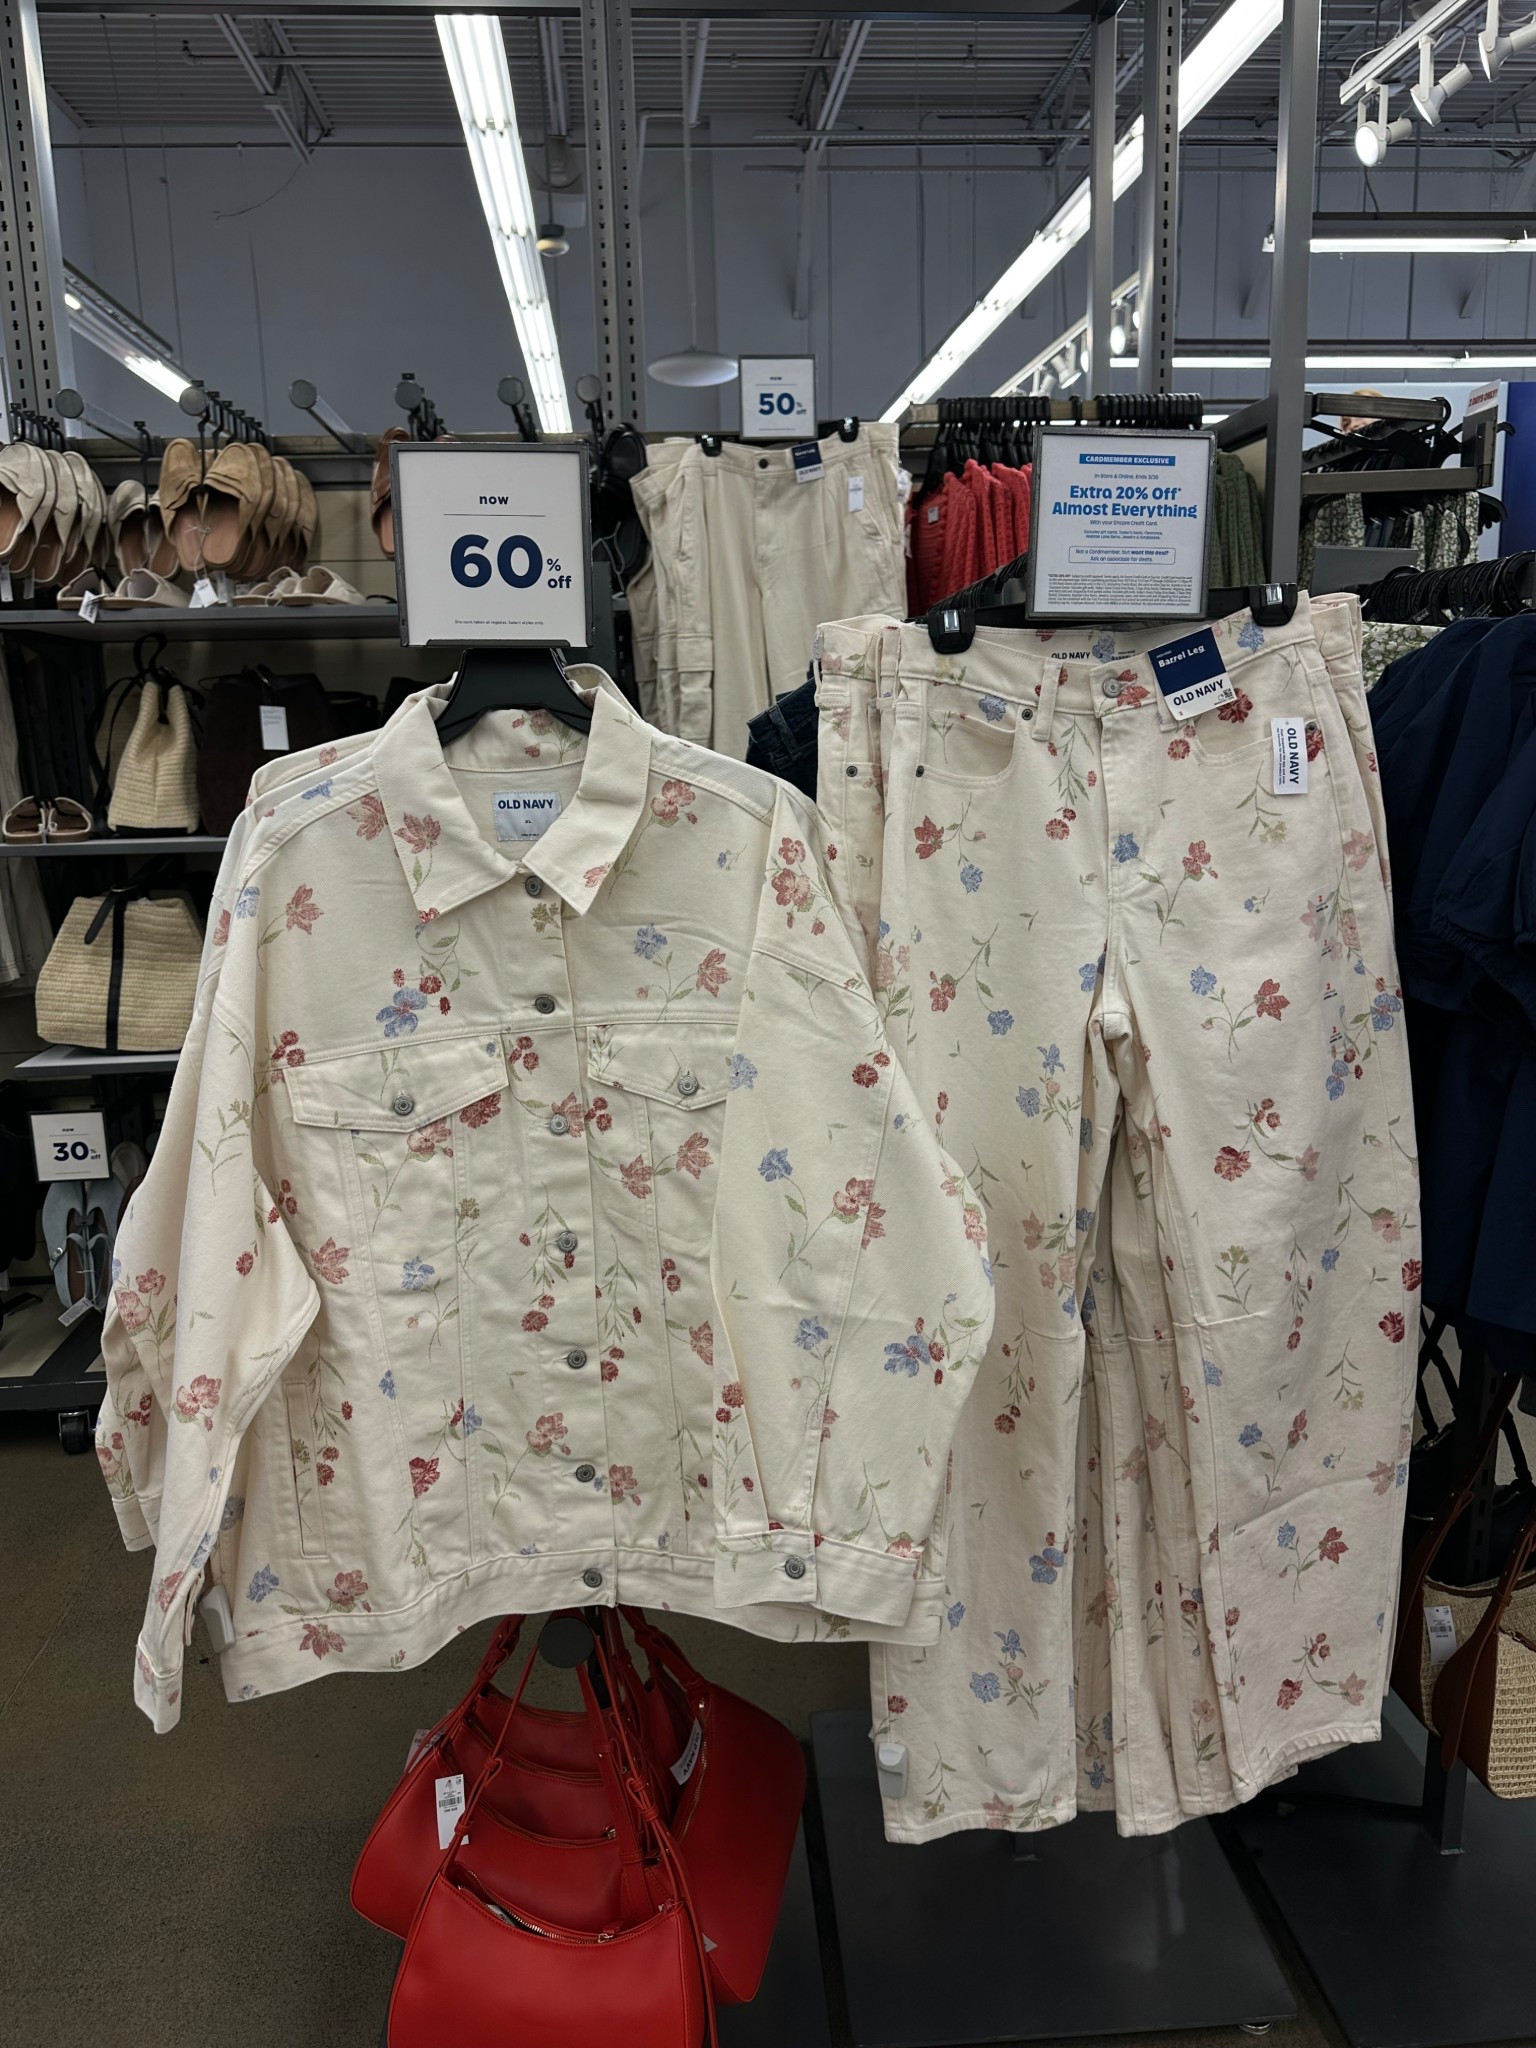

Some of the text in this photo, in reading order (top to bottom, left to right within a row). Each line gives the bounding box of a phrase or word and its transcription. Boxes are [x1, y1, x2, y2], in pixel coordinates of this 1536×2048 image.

[1085, 456, 1132, 464] CARDMEMBER
[479, 495, 509, 504] now
[1070, 485, 1112, 499] Extra
[1116, 486, 1148, 500] 20%
[1052, 502, 1198, 518] Almost Everything
[547, 576, 572, 589] off
[1158, 651, 1186, 668] Barrel
[1187, 645, 1206, 656] Leg
[1173, 692, 1194, 706] OLD
[1195, 679, 1224, 698] NAVY
[1287, 728, 1299, 784] OLD NAVY
[498, 799, 554, 809] OLD NAVY
